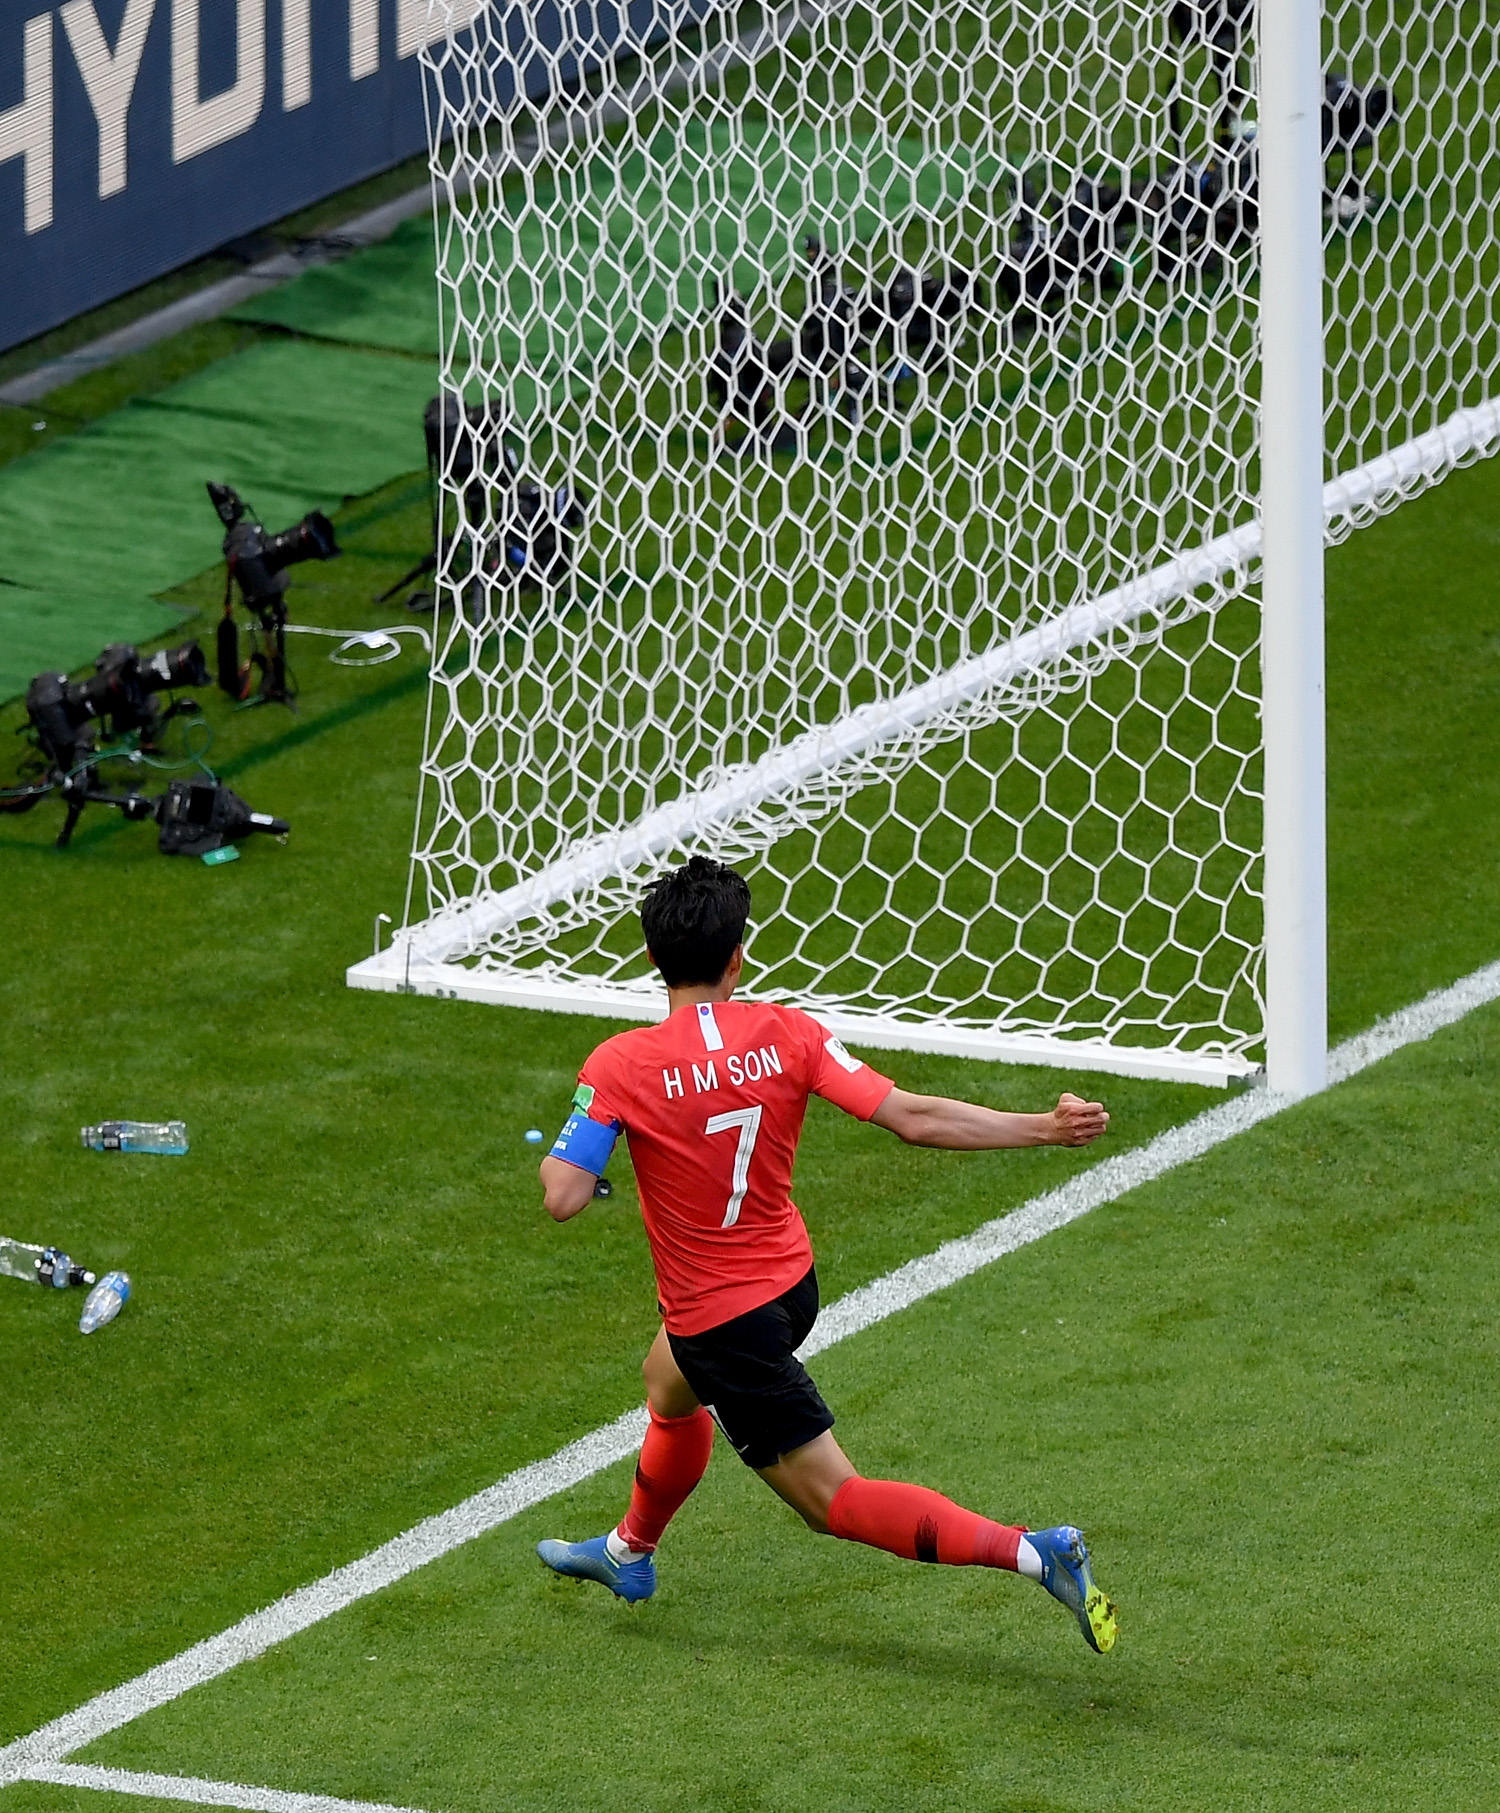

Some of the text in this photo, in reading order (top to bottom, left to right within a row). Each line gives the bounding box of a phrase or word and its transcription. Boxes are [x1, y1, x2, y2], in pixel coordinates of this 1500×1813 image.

[662, 1045, 784, 1099] H M SON
[705, 1104, 763, 1229] 7
